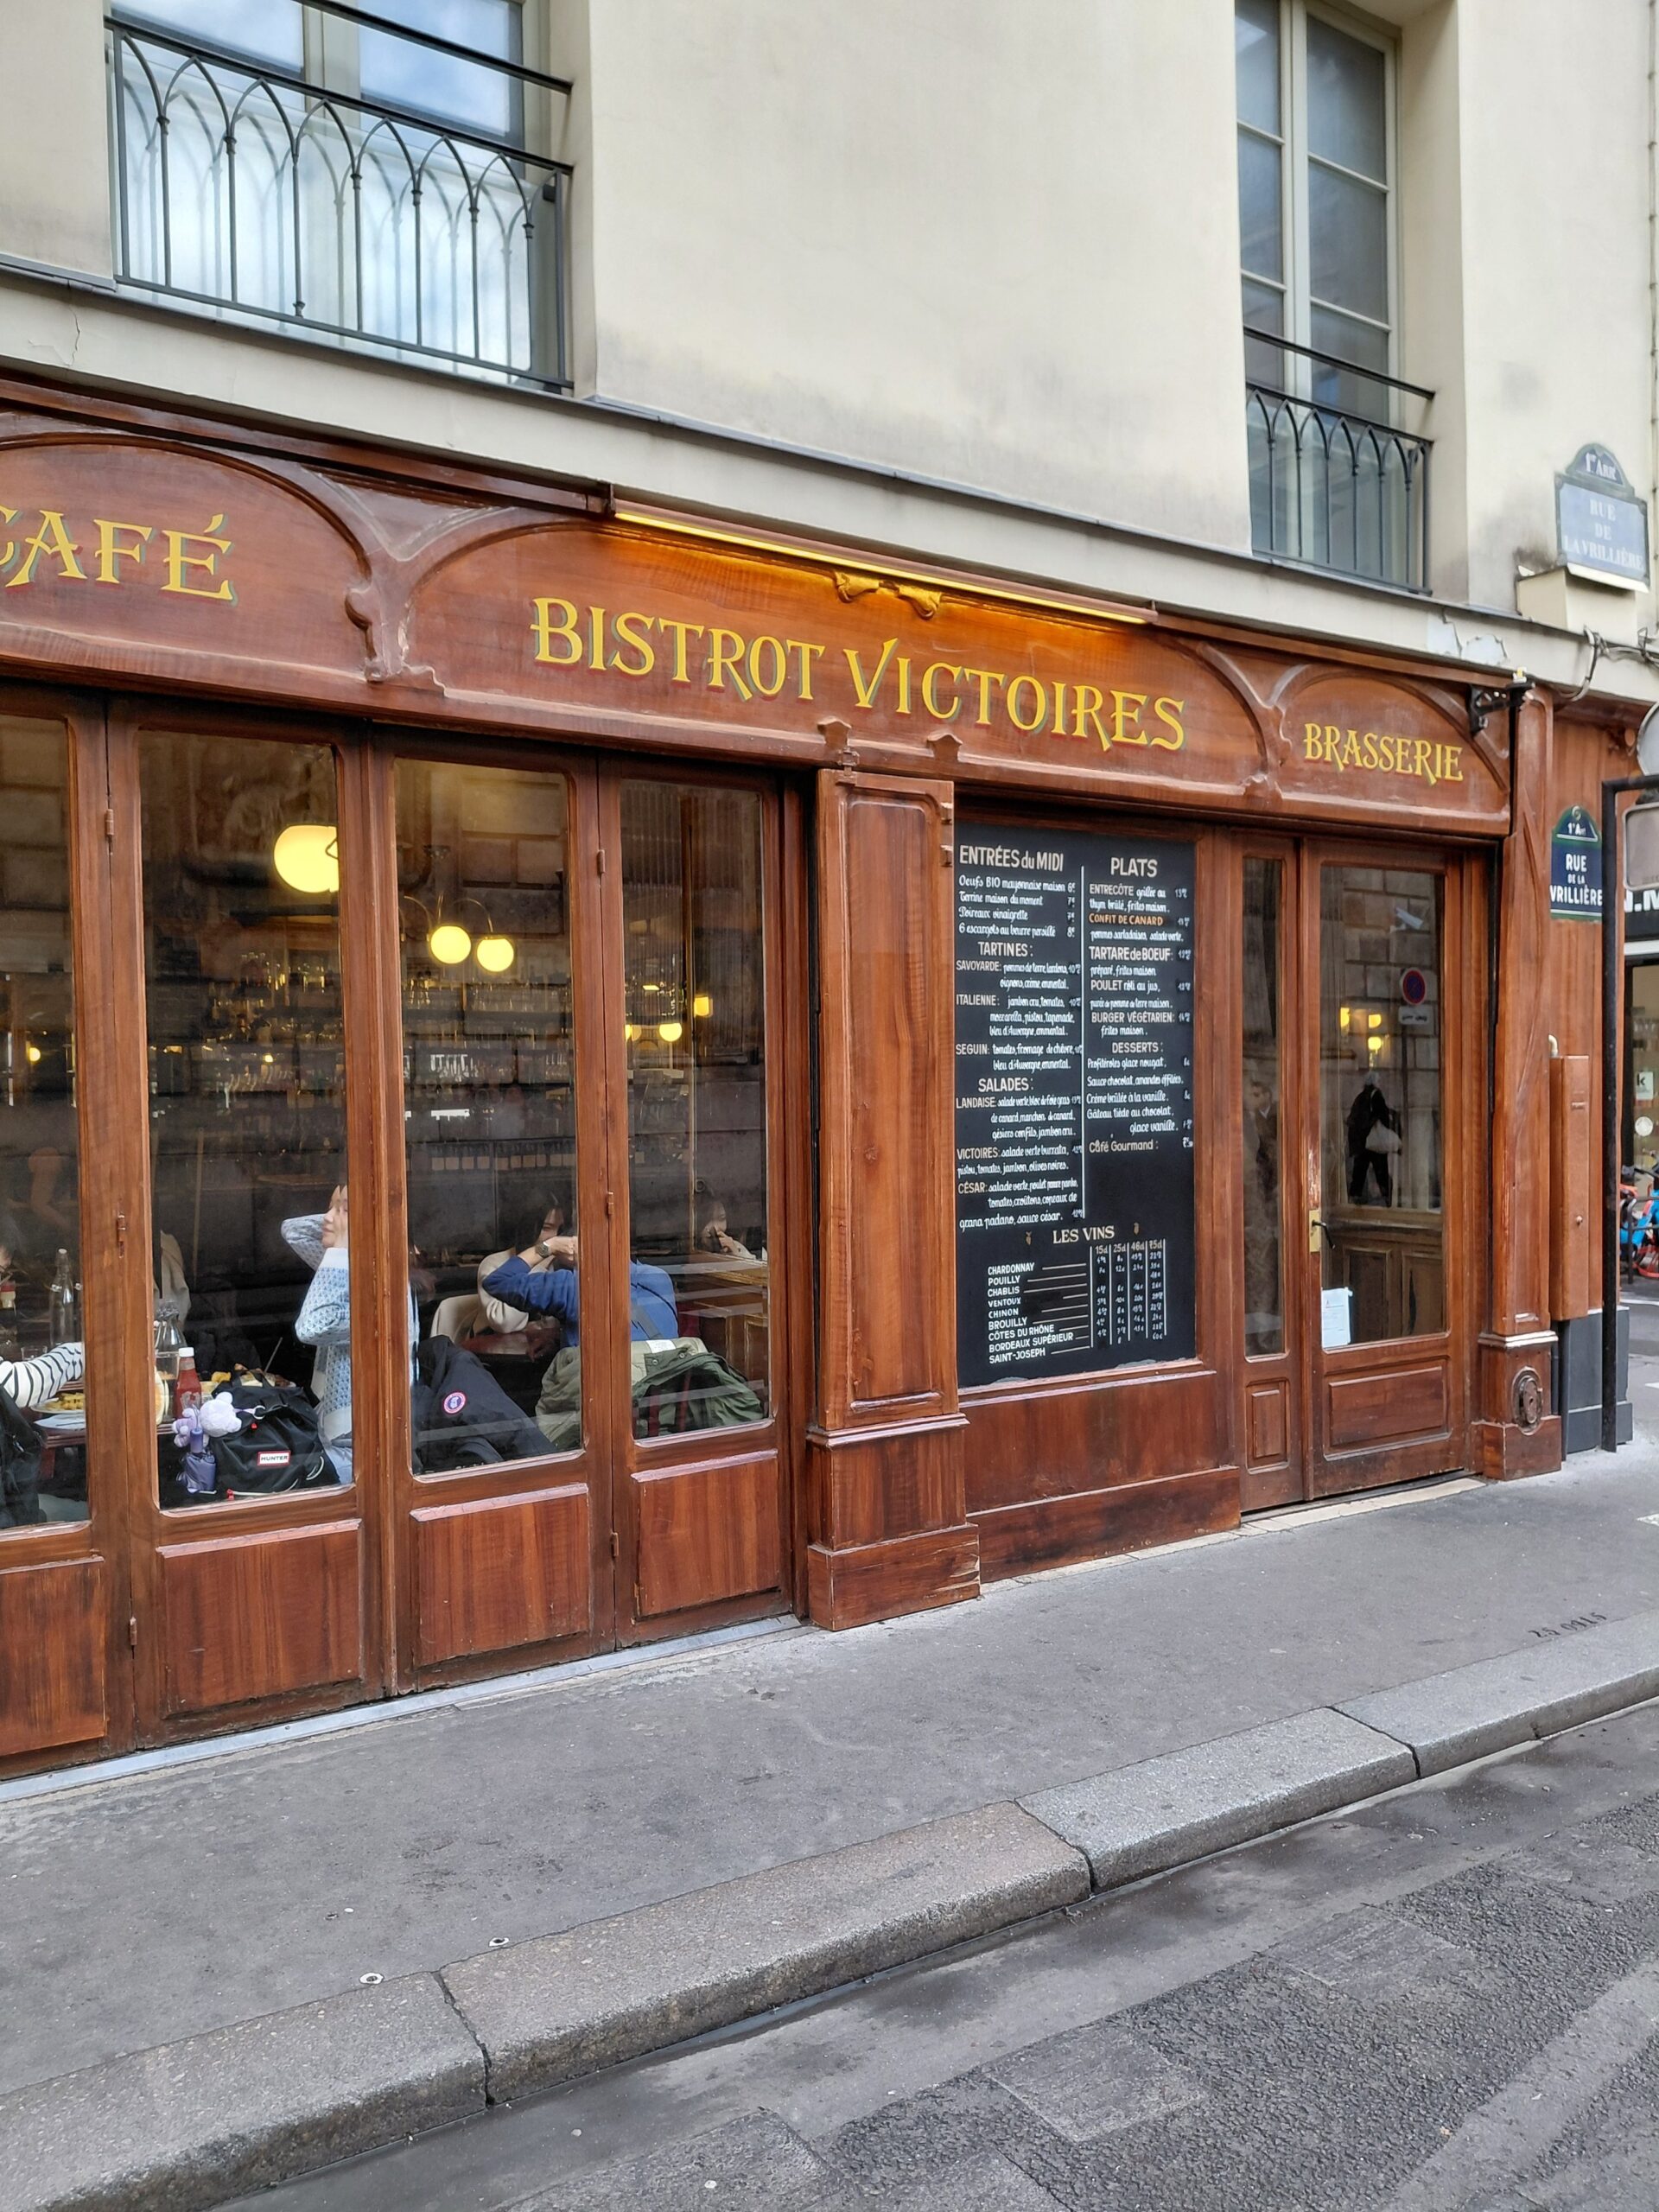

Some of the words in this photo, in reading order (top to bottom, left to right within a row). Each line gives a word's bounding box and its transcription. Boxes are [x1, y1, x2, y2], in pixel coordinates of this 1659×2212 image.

[1590, 499, 1616, 522] RUE
[1595, 523, 1611, 541] DE
[531, 597, 825, 701] BISTROT
[842, 638, 1185, 751] VICTOIRES
[1305, 723, 1463, 785] BRASSERIE
[960, 845, 1020, 868] ENTRÉES
[1021, 850, 1034, 869] du
[1037, 851, 1064, 871] MIDI
[1566, 854, 1586, 872] RUE
[1111, 857, 1158, 878] PLATS
[986, 876, 1001, 888] BIO
[1567, 874, 1576, 884] DE
[1577, 875, 1586, 885] LA
[1090, 883, 1134, 896] ENTRECÔTE
[1549, 885, 1603, 906] VRILLIÈRE
[985, 893, 1007, 904] maison
[1089, 913, 1116, 924] CONFIT
[1119, 915, 1128, 924] DE
[1129, 915, 1163, 925] CANARD
[959, 923, 964, 933] 6
[1089, 946, 1129, 961] TARTARE
[1130, 948, 1141, 961] de
[1091, 980, 1122, 990] POULET
[1091, 1012, 1124, 1023] BURGER
[1101, 1025, 1118, 1039] frites
[1069, 1192, 1077, 1202] de
[959, 1218, 983, 1233] grana
[1016, 1214, 1039, 1224] sauce
[1052, 1229, 1078, 1244] LES
[1083, 1225, 1115, 1241] VINS
[988, 1262, 1035, 1275] CHARDONNAY
[988, 1275, 1020, 1287] POUILLY
[988, 1287, 1020, 1297] CHABLIS
[988, 1297, 1021, 1307] VENTOUX
[988, 1308, 1019, 1319] CHINON
[988, 1317, 1027, 1331] BROUILLY
[988, 1329, 1015, 1341] CÔTES
[1017, 1328, 1027, 1338] DU
[1028, 1325, 1054, 1336] RHÔNE
[989, 1339, 1030, 1352] BORDEAUX
[1033, 1332, 1074, 1346] SUPÉRIEUR
[989, 1348, 1046, 1363] SAINT-JOSEPH
